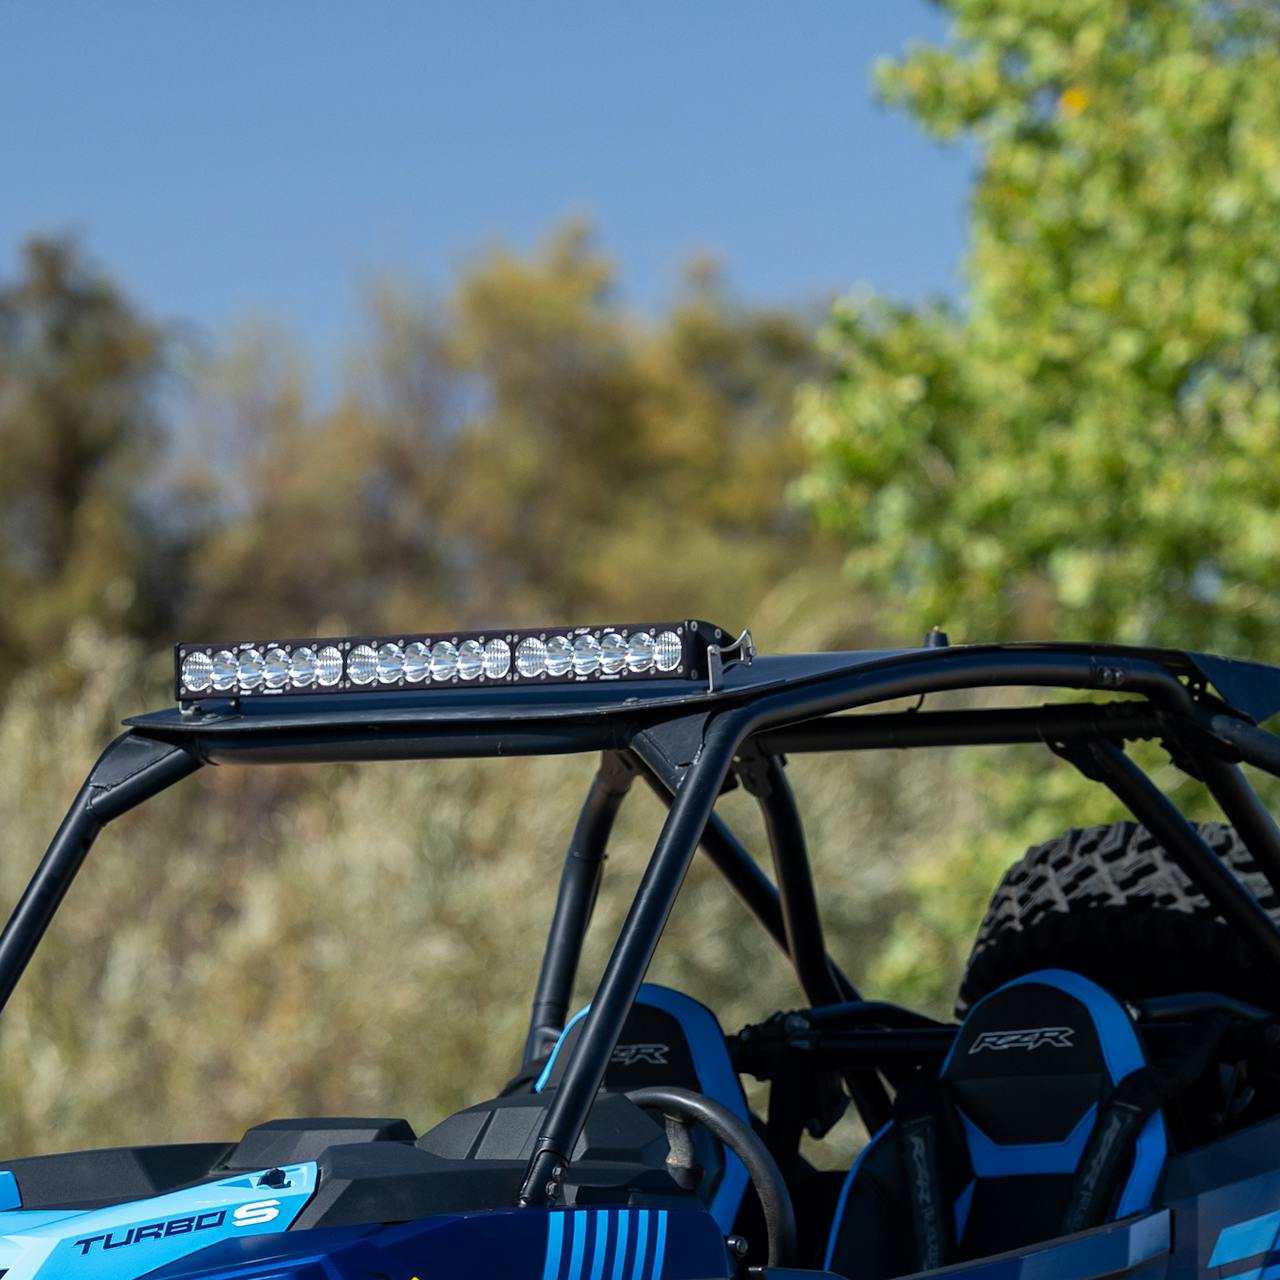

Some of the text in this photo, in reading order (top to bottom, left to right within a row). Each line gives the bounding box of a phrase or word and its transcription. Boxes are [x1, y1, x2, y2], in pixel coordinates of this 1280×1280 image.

[968, 1026, 1074, 1054] RZR
[73, 1199, 281, 1255] TURBO S
